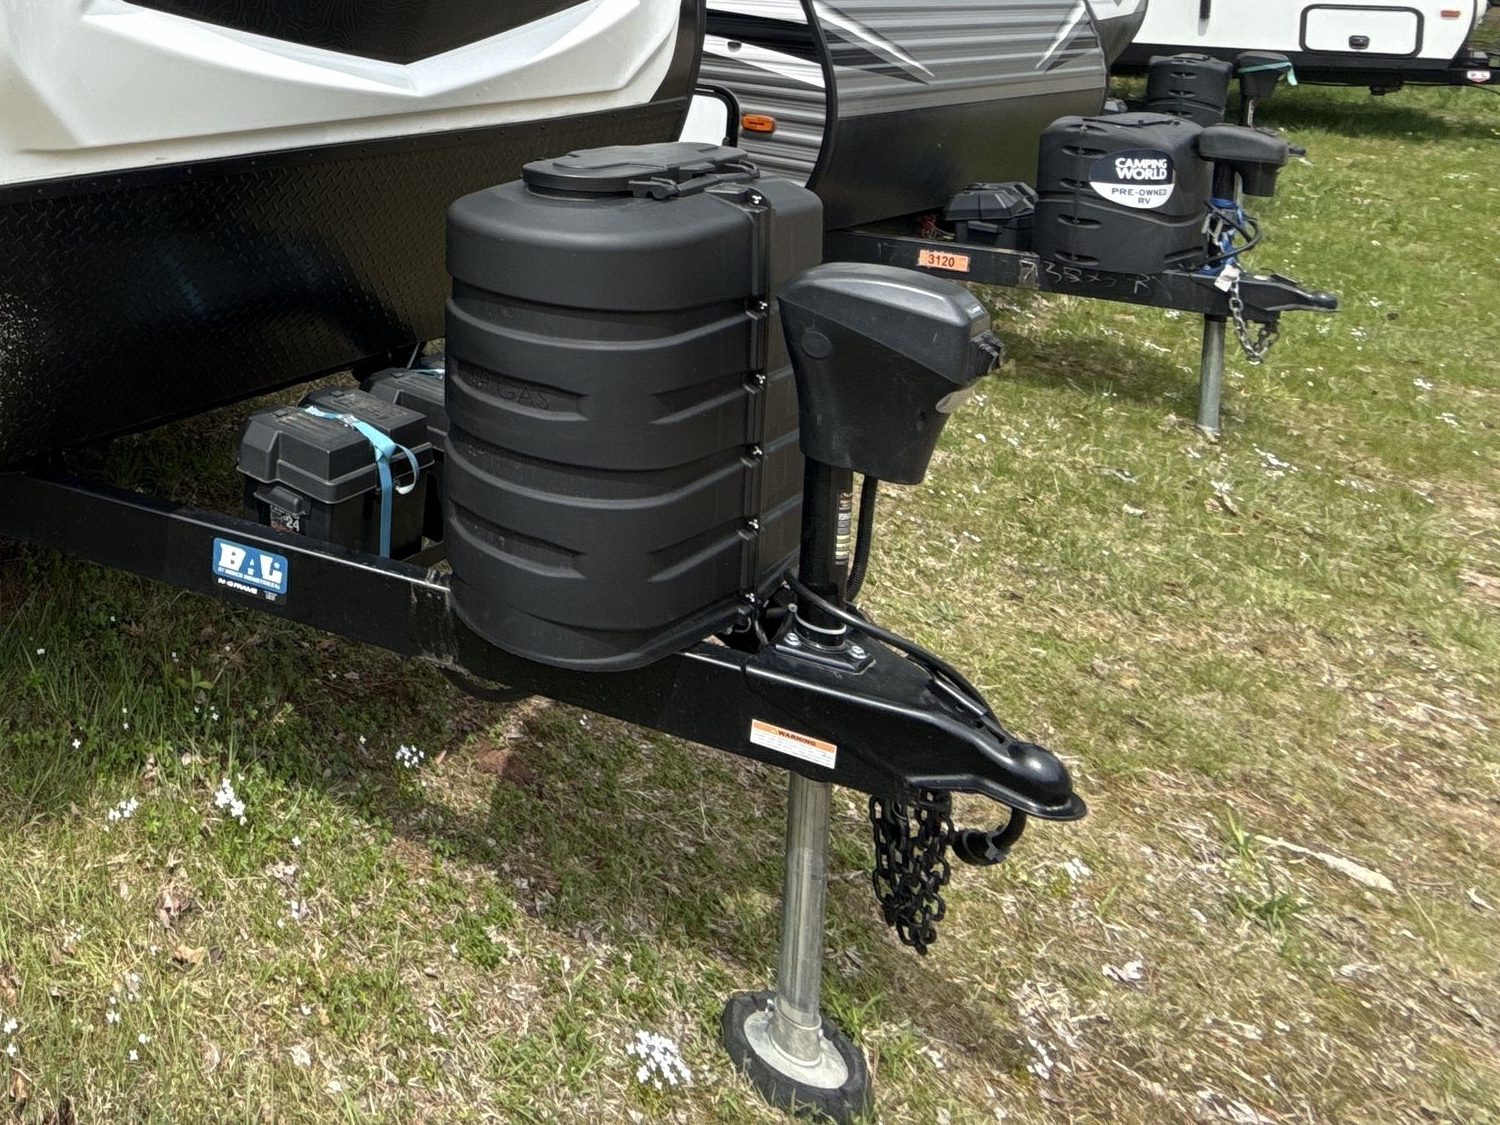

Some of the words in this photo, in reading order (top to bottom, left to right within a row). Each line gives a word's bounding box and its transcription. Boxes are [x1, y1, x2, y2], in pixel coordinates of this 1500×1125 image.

[1115, 157, 1168, 169] CAMPING
[1115, 167, 1168, 180] WORLD
[1111, 187, 1168, 196] PRE-OWNED
[1137, 197, 1151, 205] RV
[927, 254, 955, 268] 3120
[286, 515, 300, 532] 24
[778, 730, 816, 746] WARNING
